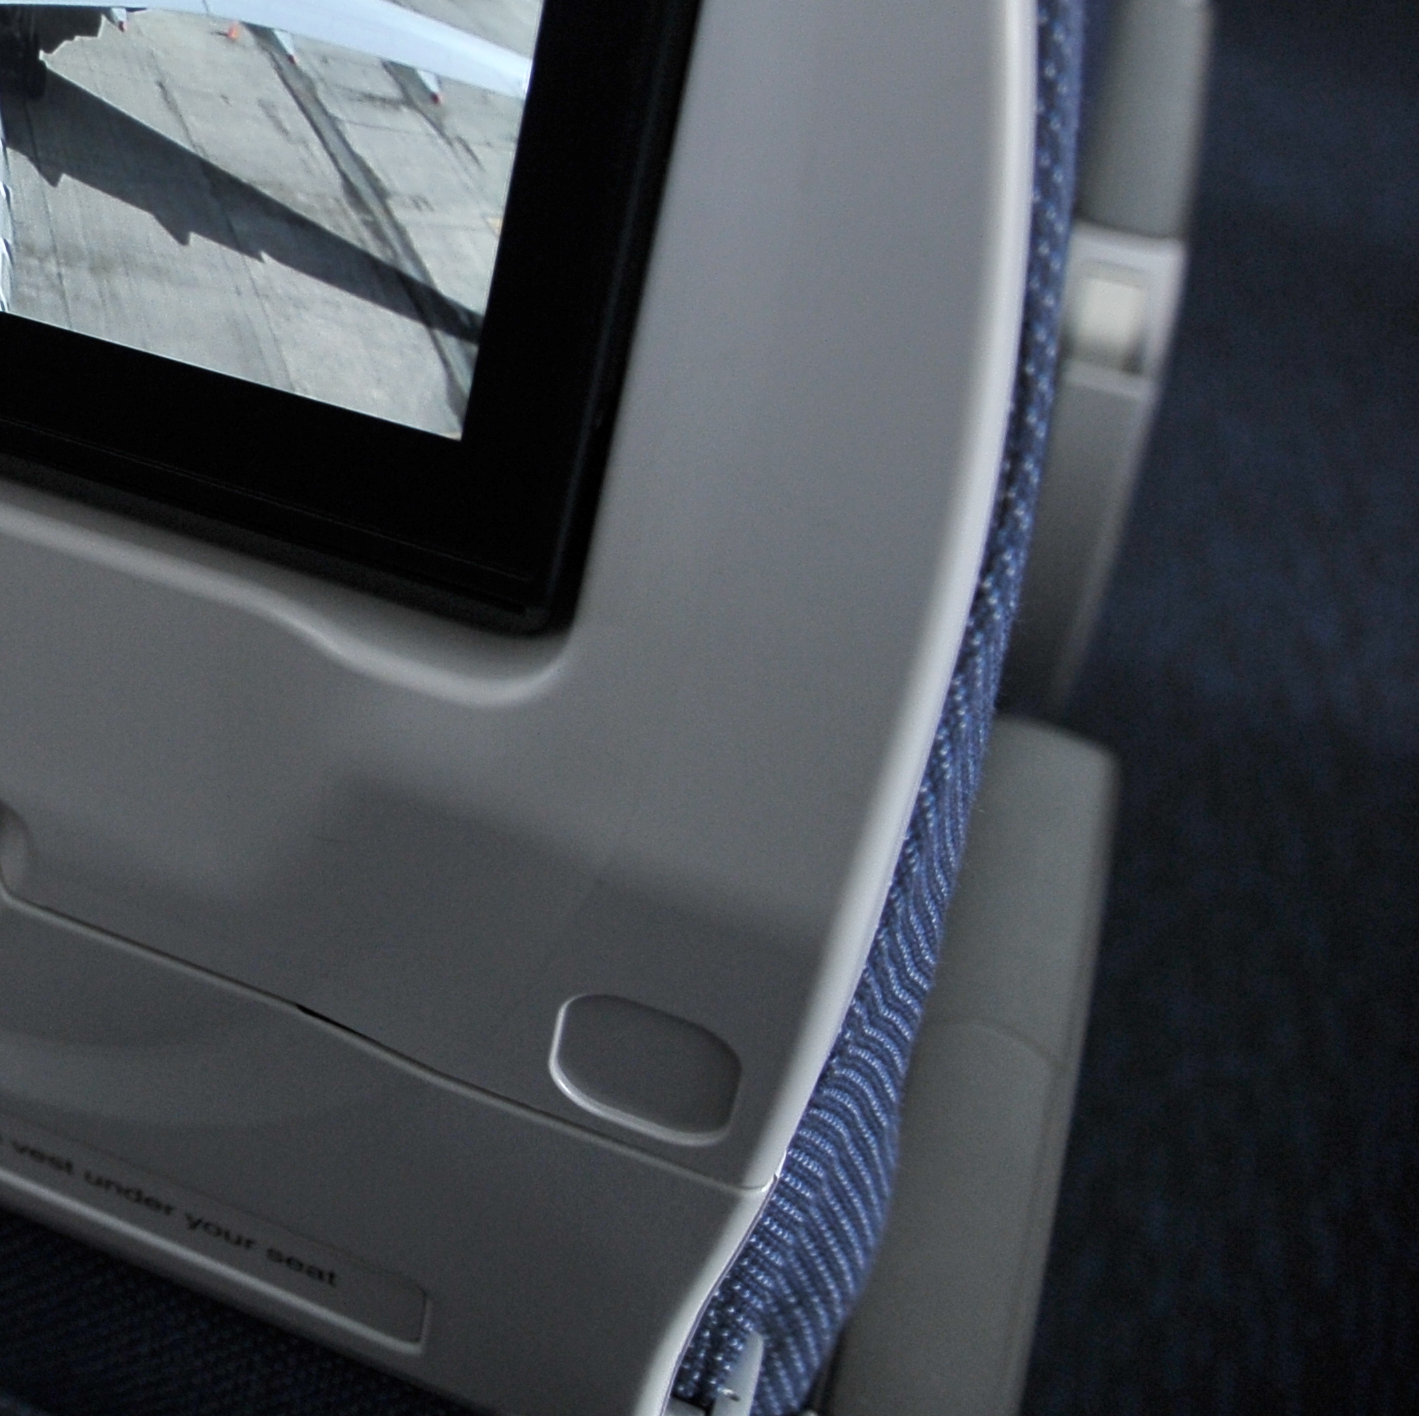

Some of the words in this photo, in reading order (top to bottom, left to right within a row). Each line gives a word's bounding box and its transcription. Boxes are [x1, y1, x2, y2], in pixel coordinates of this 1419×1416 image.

[11, 1141, 74, 1175] vest
[83, 1170, 175, 1217] under
[183, 1210, 256, 1251] your
[266, 1245, 339, 1288] seat
